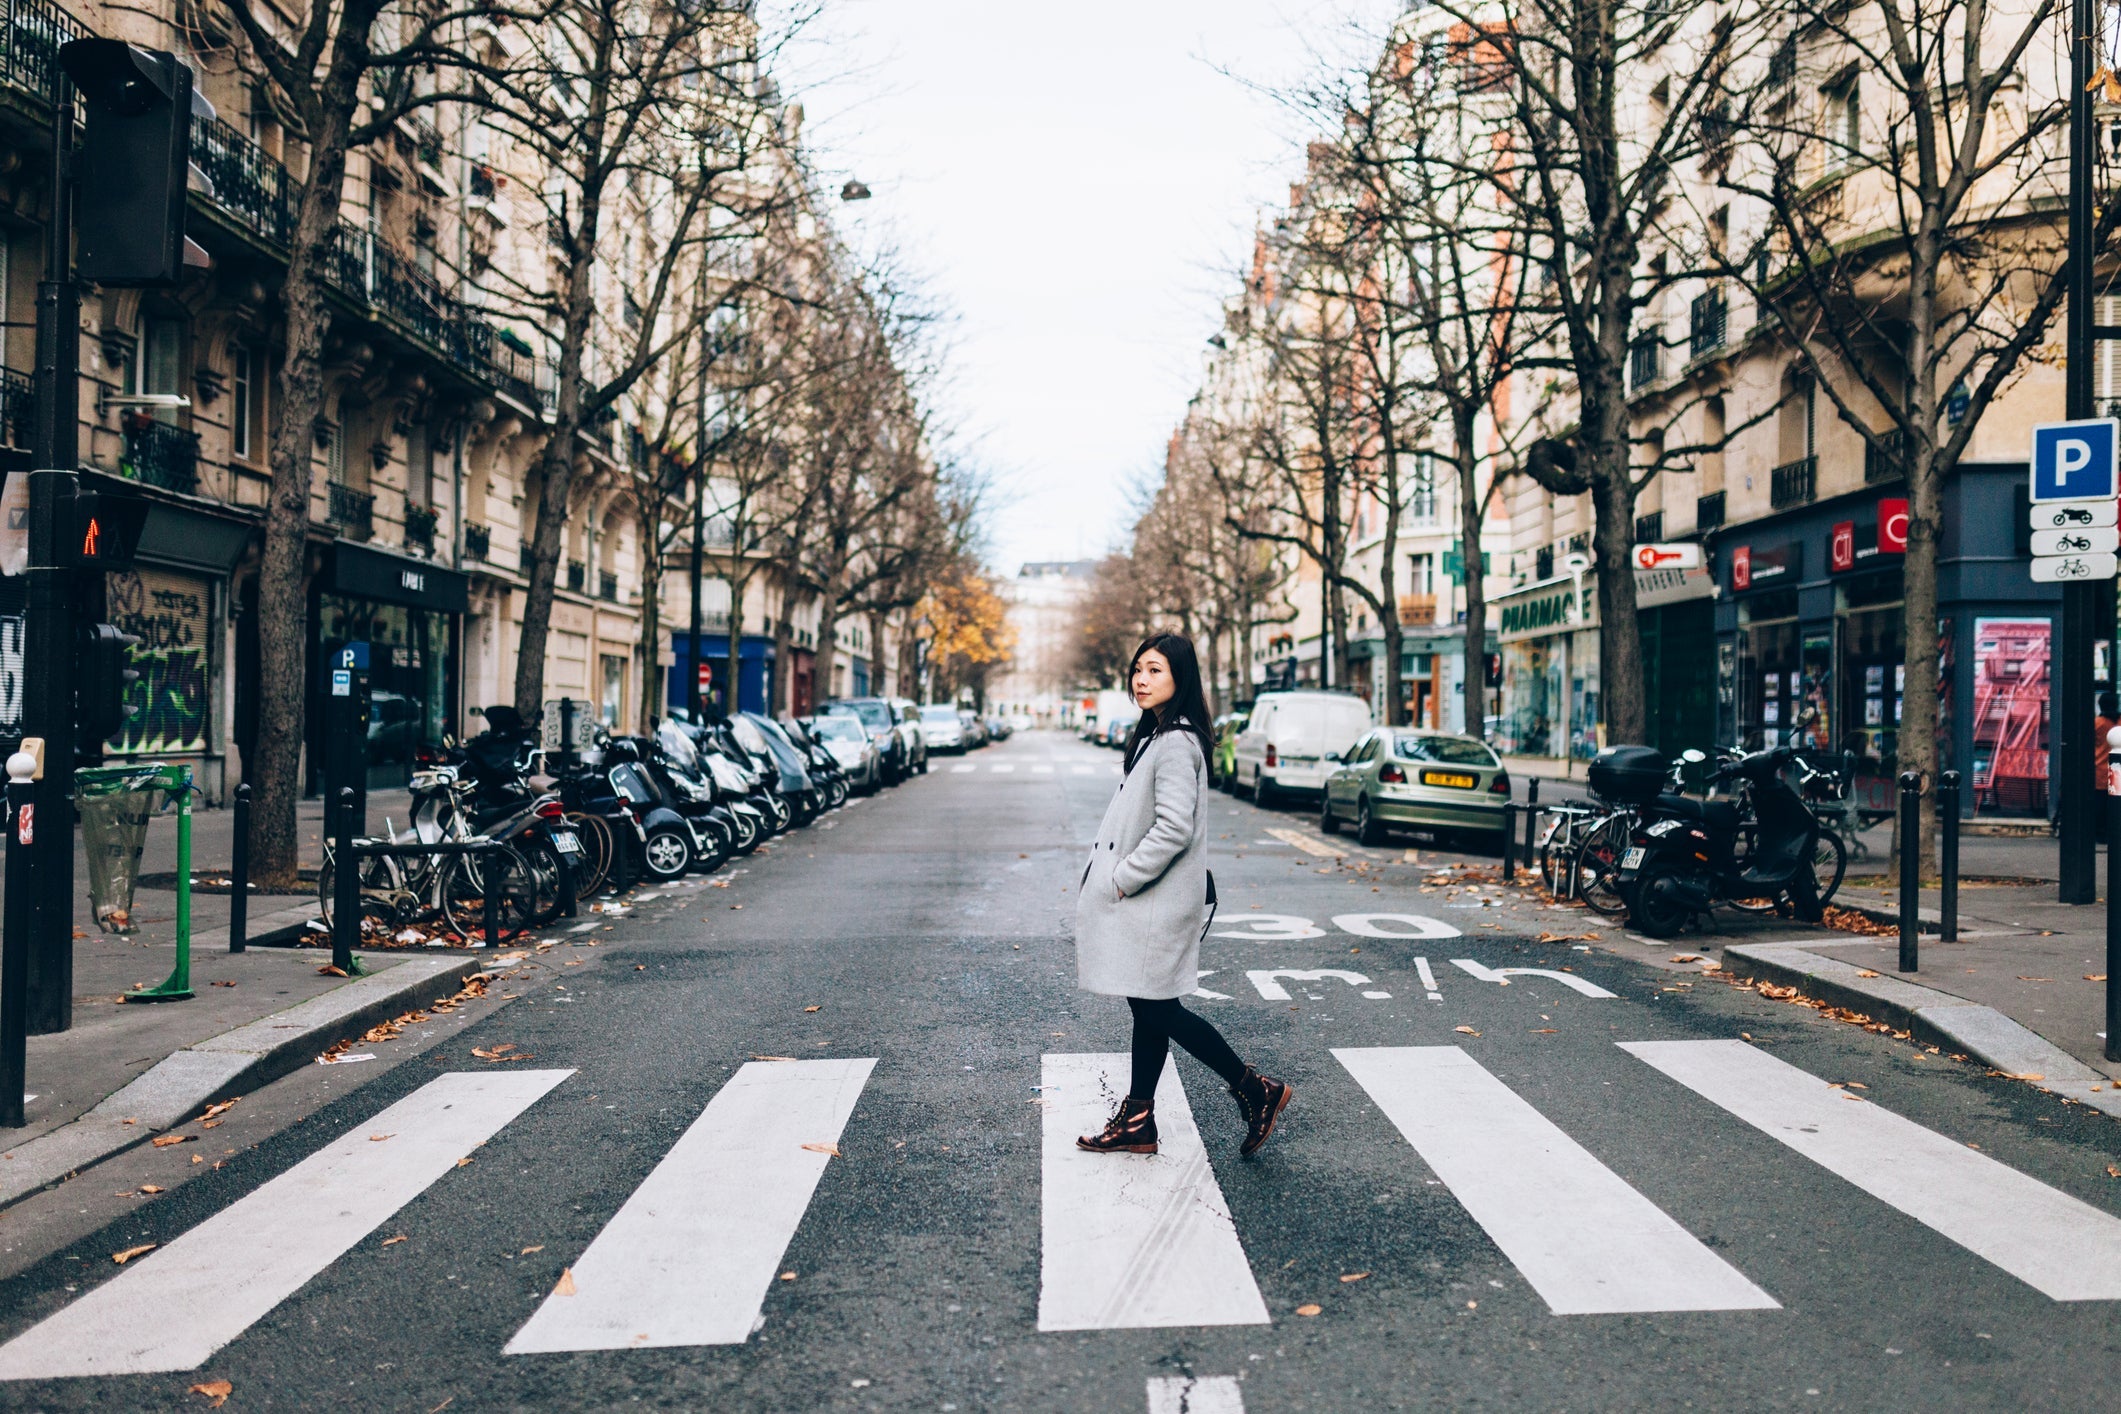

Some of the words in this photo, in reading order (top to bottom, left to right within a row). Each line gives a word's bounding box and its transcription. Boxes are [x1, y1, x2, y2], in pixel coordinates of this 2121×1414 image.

[2055, 439, 2092, 487] P
[1886, 513, 1909, 544] C
[1637, 567, 1687, 593] RURERIE
[1501, 588, 1593, 635] PHARMACE
[342, 649, 355, 669] P
[1203, 913, 1462, 940] 30
[1196, 956, 1620, 1002] m/h
